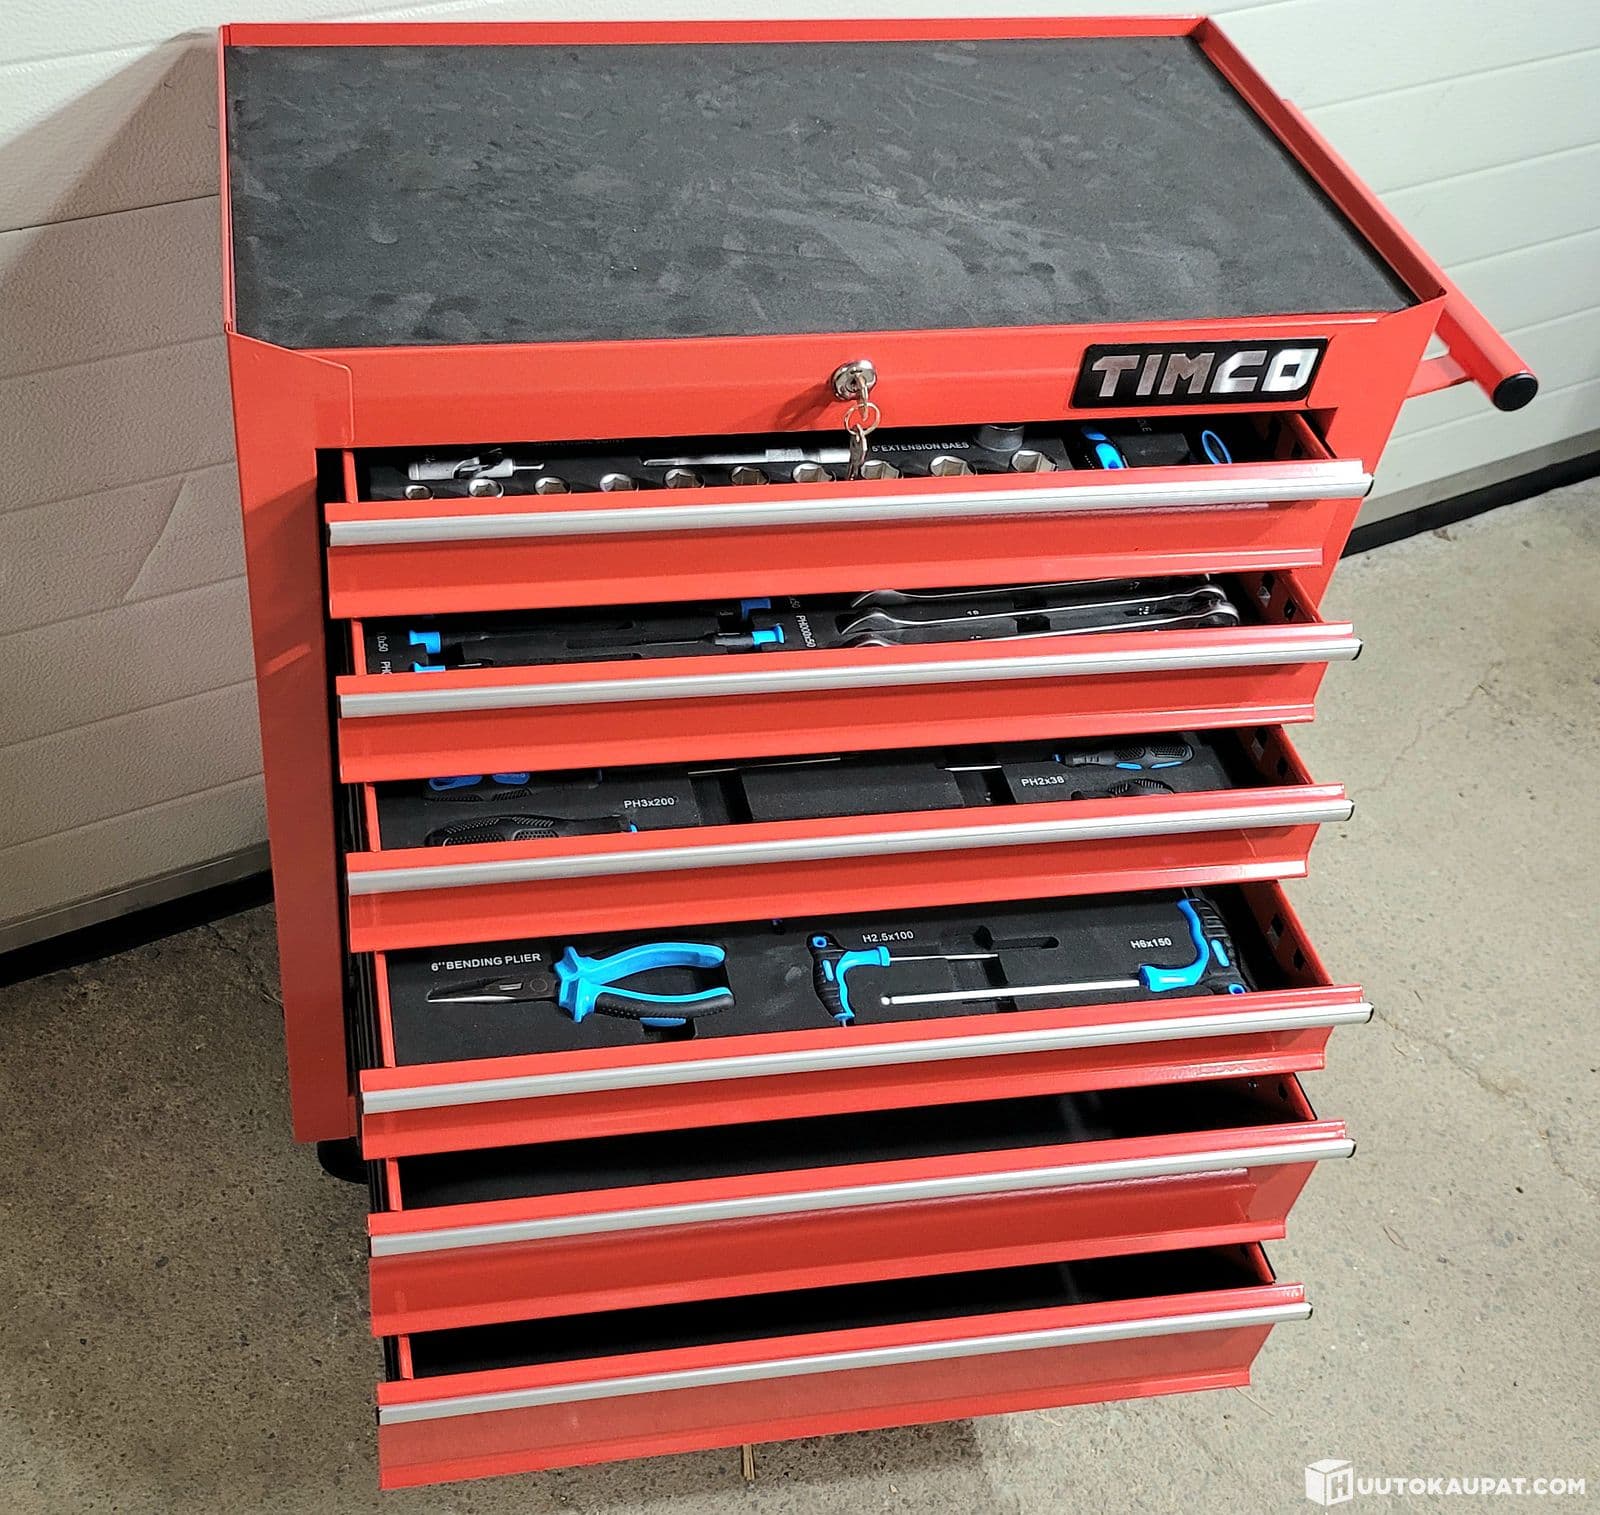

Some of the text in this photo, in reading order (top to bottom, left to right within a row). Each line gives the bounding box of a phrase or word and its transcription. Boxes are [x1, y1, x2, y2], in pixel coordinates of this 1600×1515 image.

[1091, 348, 1320, 398] TIMCO
[623, 796, 676, 809] PH3x200
[862, 930, 915, 944] H2.5x100
[1130, 936, 1173, 950] H6x150
[504, 952, 542, 965] PLIER
